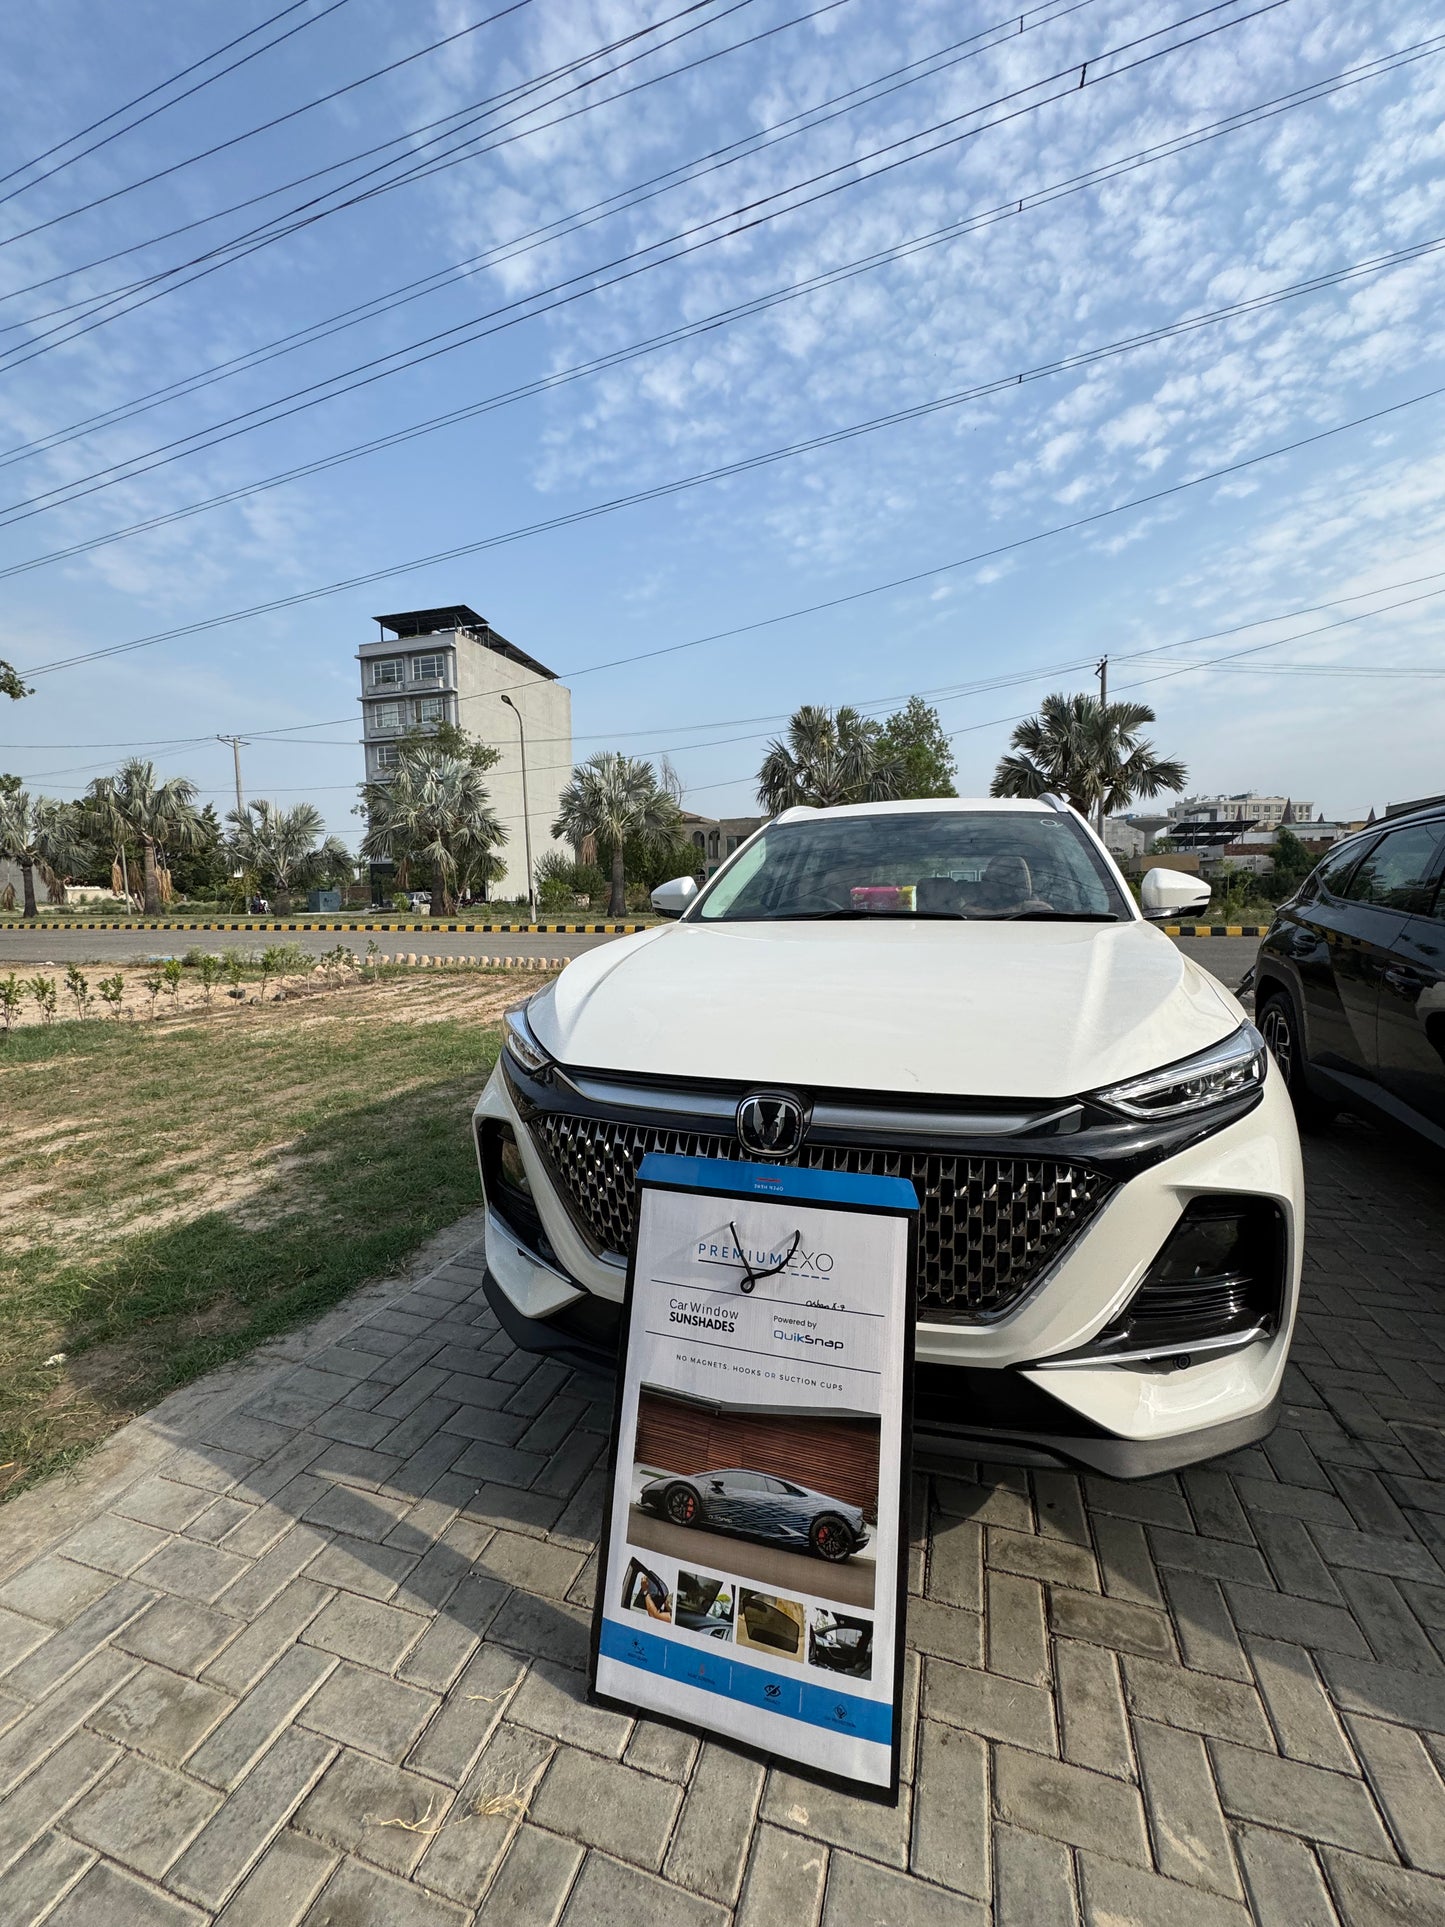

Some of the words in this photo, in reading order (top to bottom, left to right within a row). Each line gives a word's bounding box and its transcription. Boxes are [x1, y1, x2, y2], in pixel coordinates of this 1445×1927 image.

[669, 1298, 687, 1311] Car
[690, 1301, 739, 1320] Window
[669, 1311, 735, 1333] SUNSHADES
[773, 1315, 806, 1327] Powered
[807, 1319, 817, 1330] by
[773, 1329, 844, 1350] QuikSnap
[676, 1354, 688, 1362] NO
[732, 1365, 762, 1377] HOOKS
[764, 1371, 776, 1379] OR
[779, 1374, 817, 1387] SUCTION
[820, 1381, 843, 1391] CUPS
